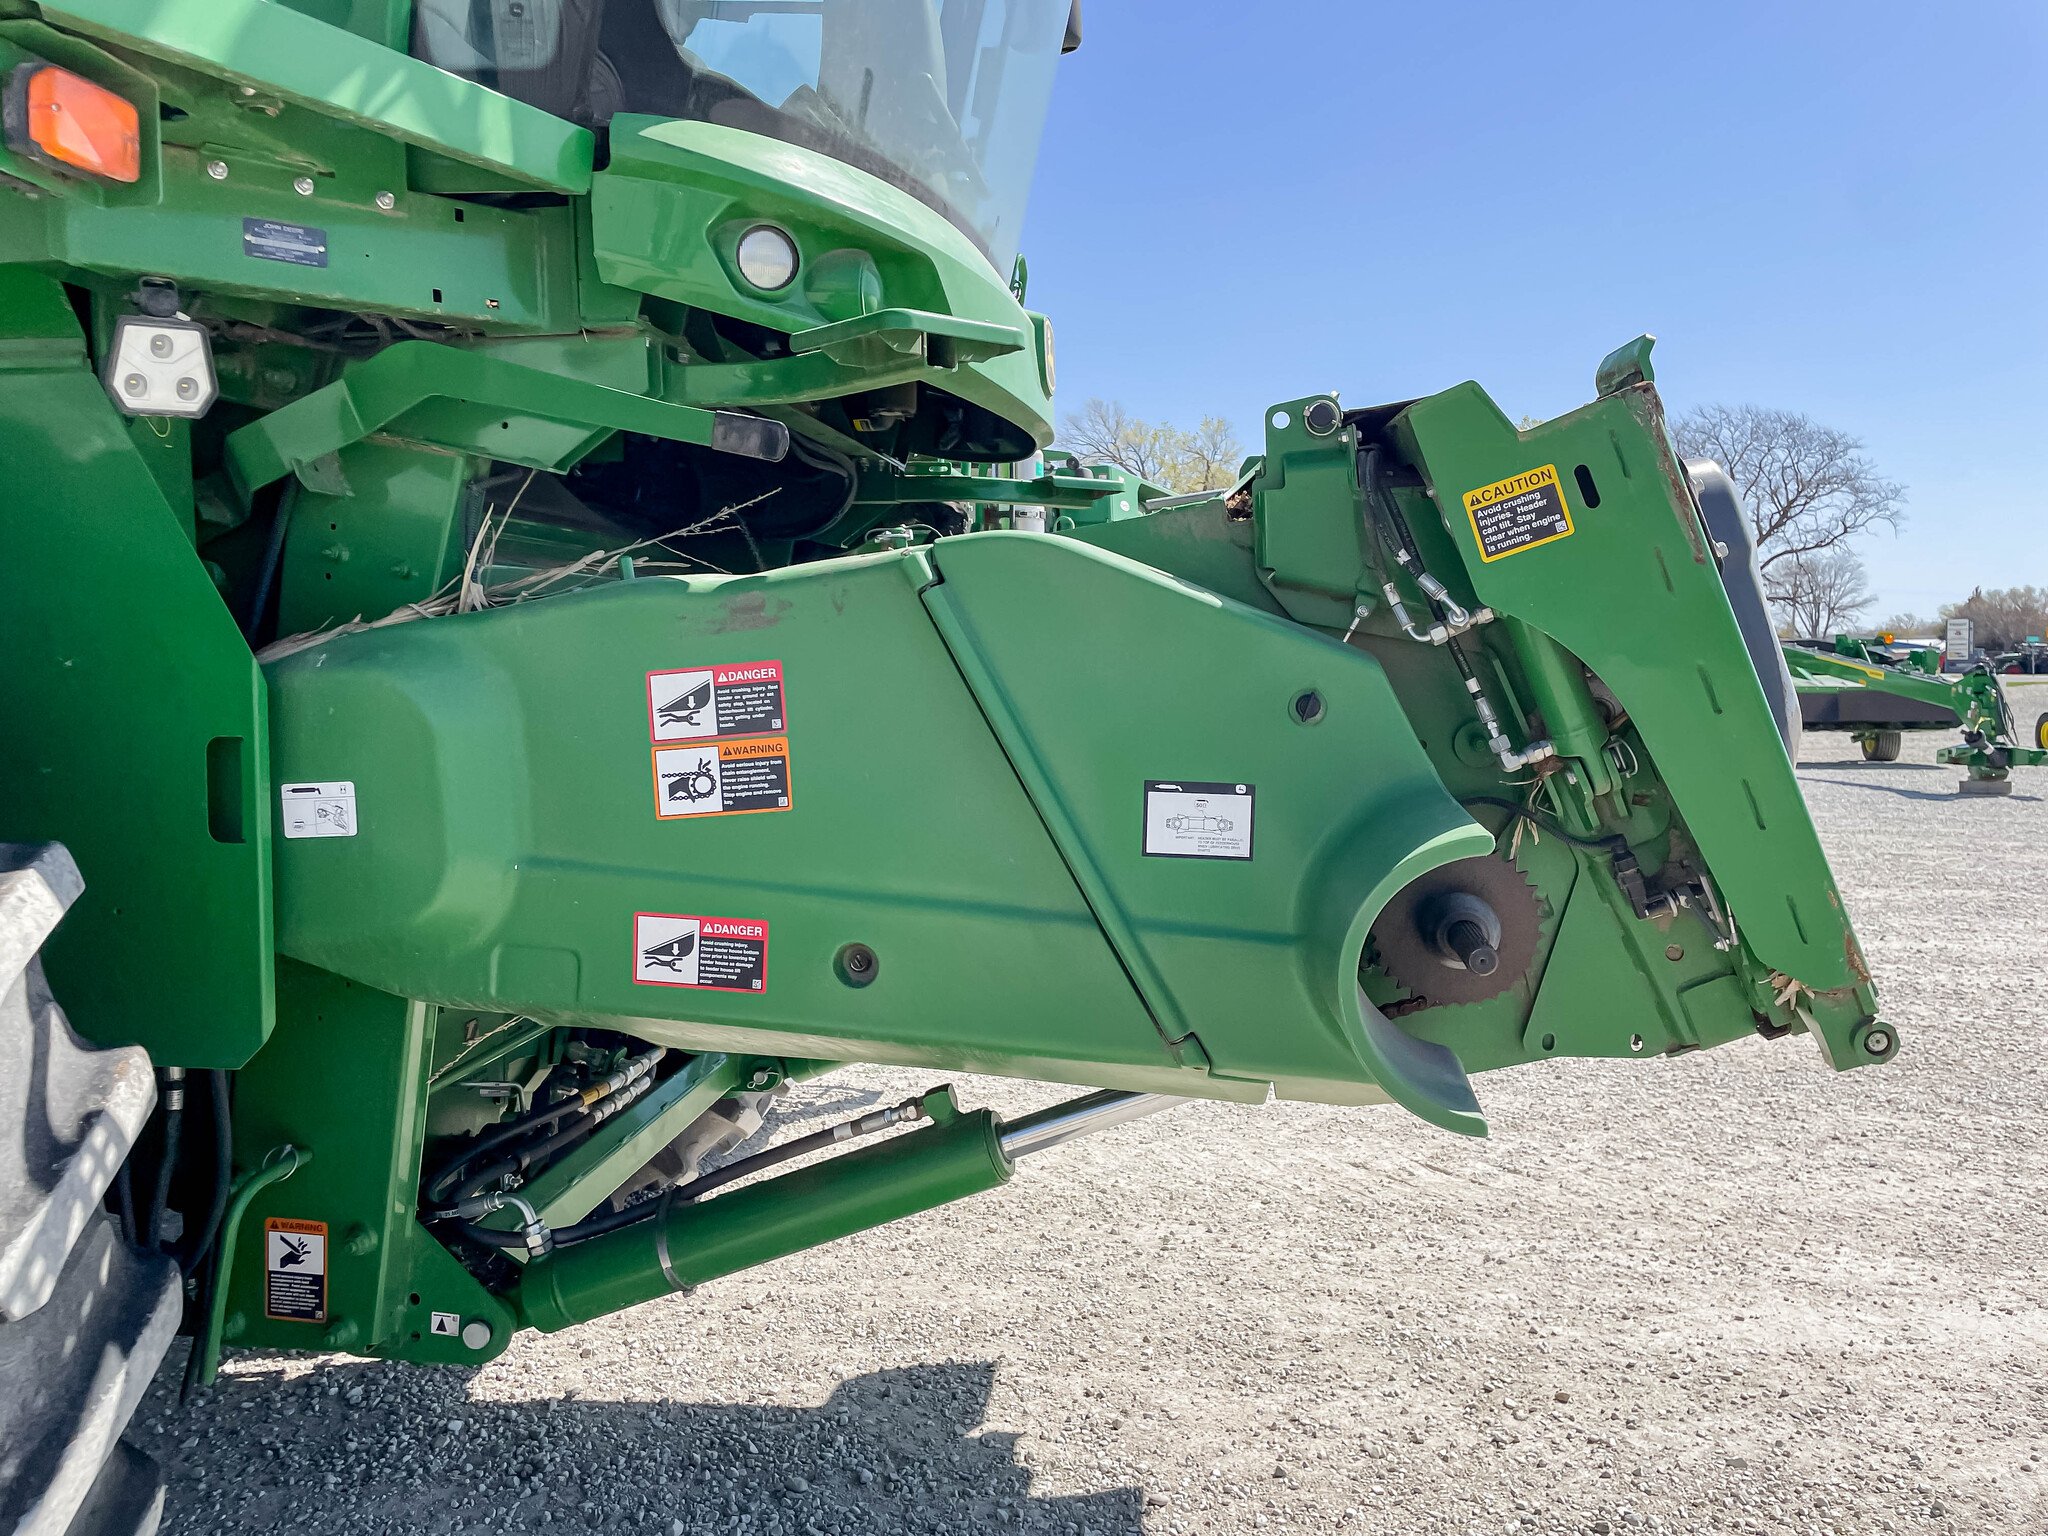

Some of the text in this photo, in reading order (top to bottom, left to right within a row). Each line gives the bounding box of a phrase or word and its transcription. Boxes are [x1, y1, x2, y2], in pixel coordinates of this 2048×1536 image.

[1482, 469, 1552, 501] CAUTION
[1477, 492, 1540, 518] Avoid crushing
[1480, 499, 1547, 526] injuries. Header
[1483, 513, 1536, 535] can tilt. Stay
[1485, 514, 1560, 543] clear when engine
[1488, 534, 1532, 552] is running.
[728, 668, 776, 681] DANGER
[734, 744, 782, 754] WARNING
[714, 924, 762, 936] DANGER
[281, 1222, 323, 1232] WARNING
